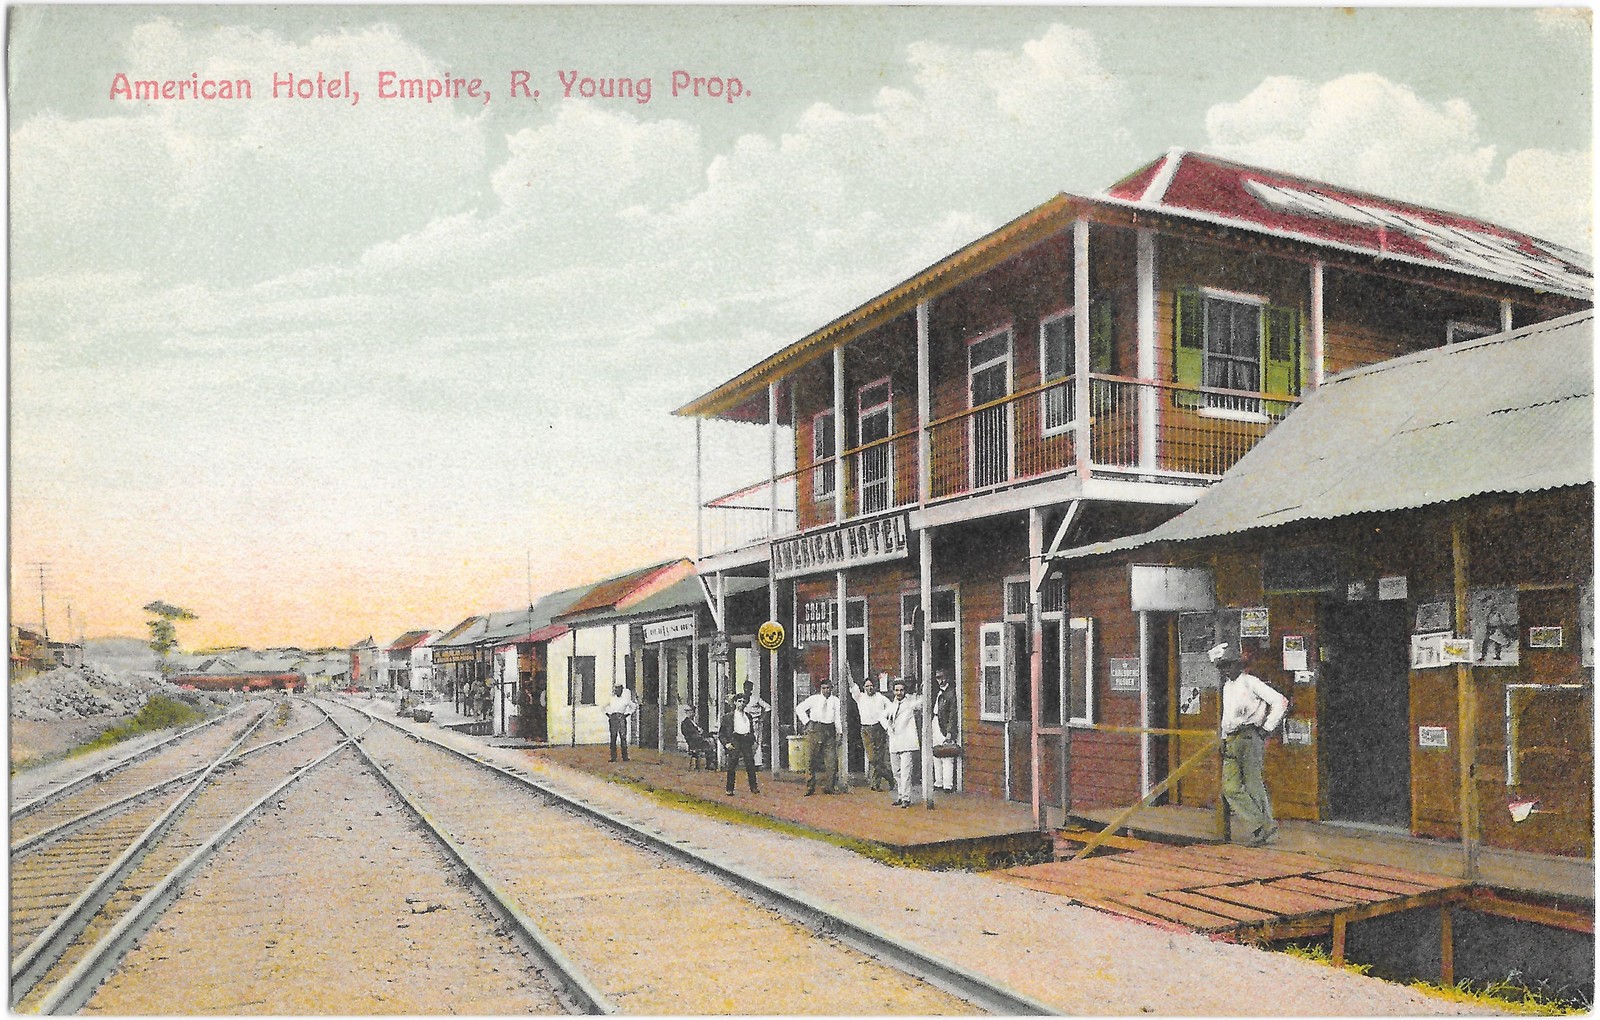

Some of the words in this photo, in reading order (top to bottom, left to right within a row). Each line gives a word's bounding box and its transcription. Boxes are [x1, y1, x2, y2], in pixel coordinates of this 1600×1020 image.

[773, 530, 845, 575] AMERICAN
[846, 515, 906, 559] HOTEL
[805, 602, 826, 621] COLD
